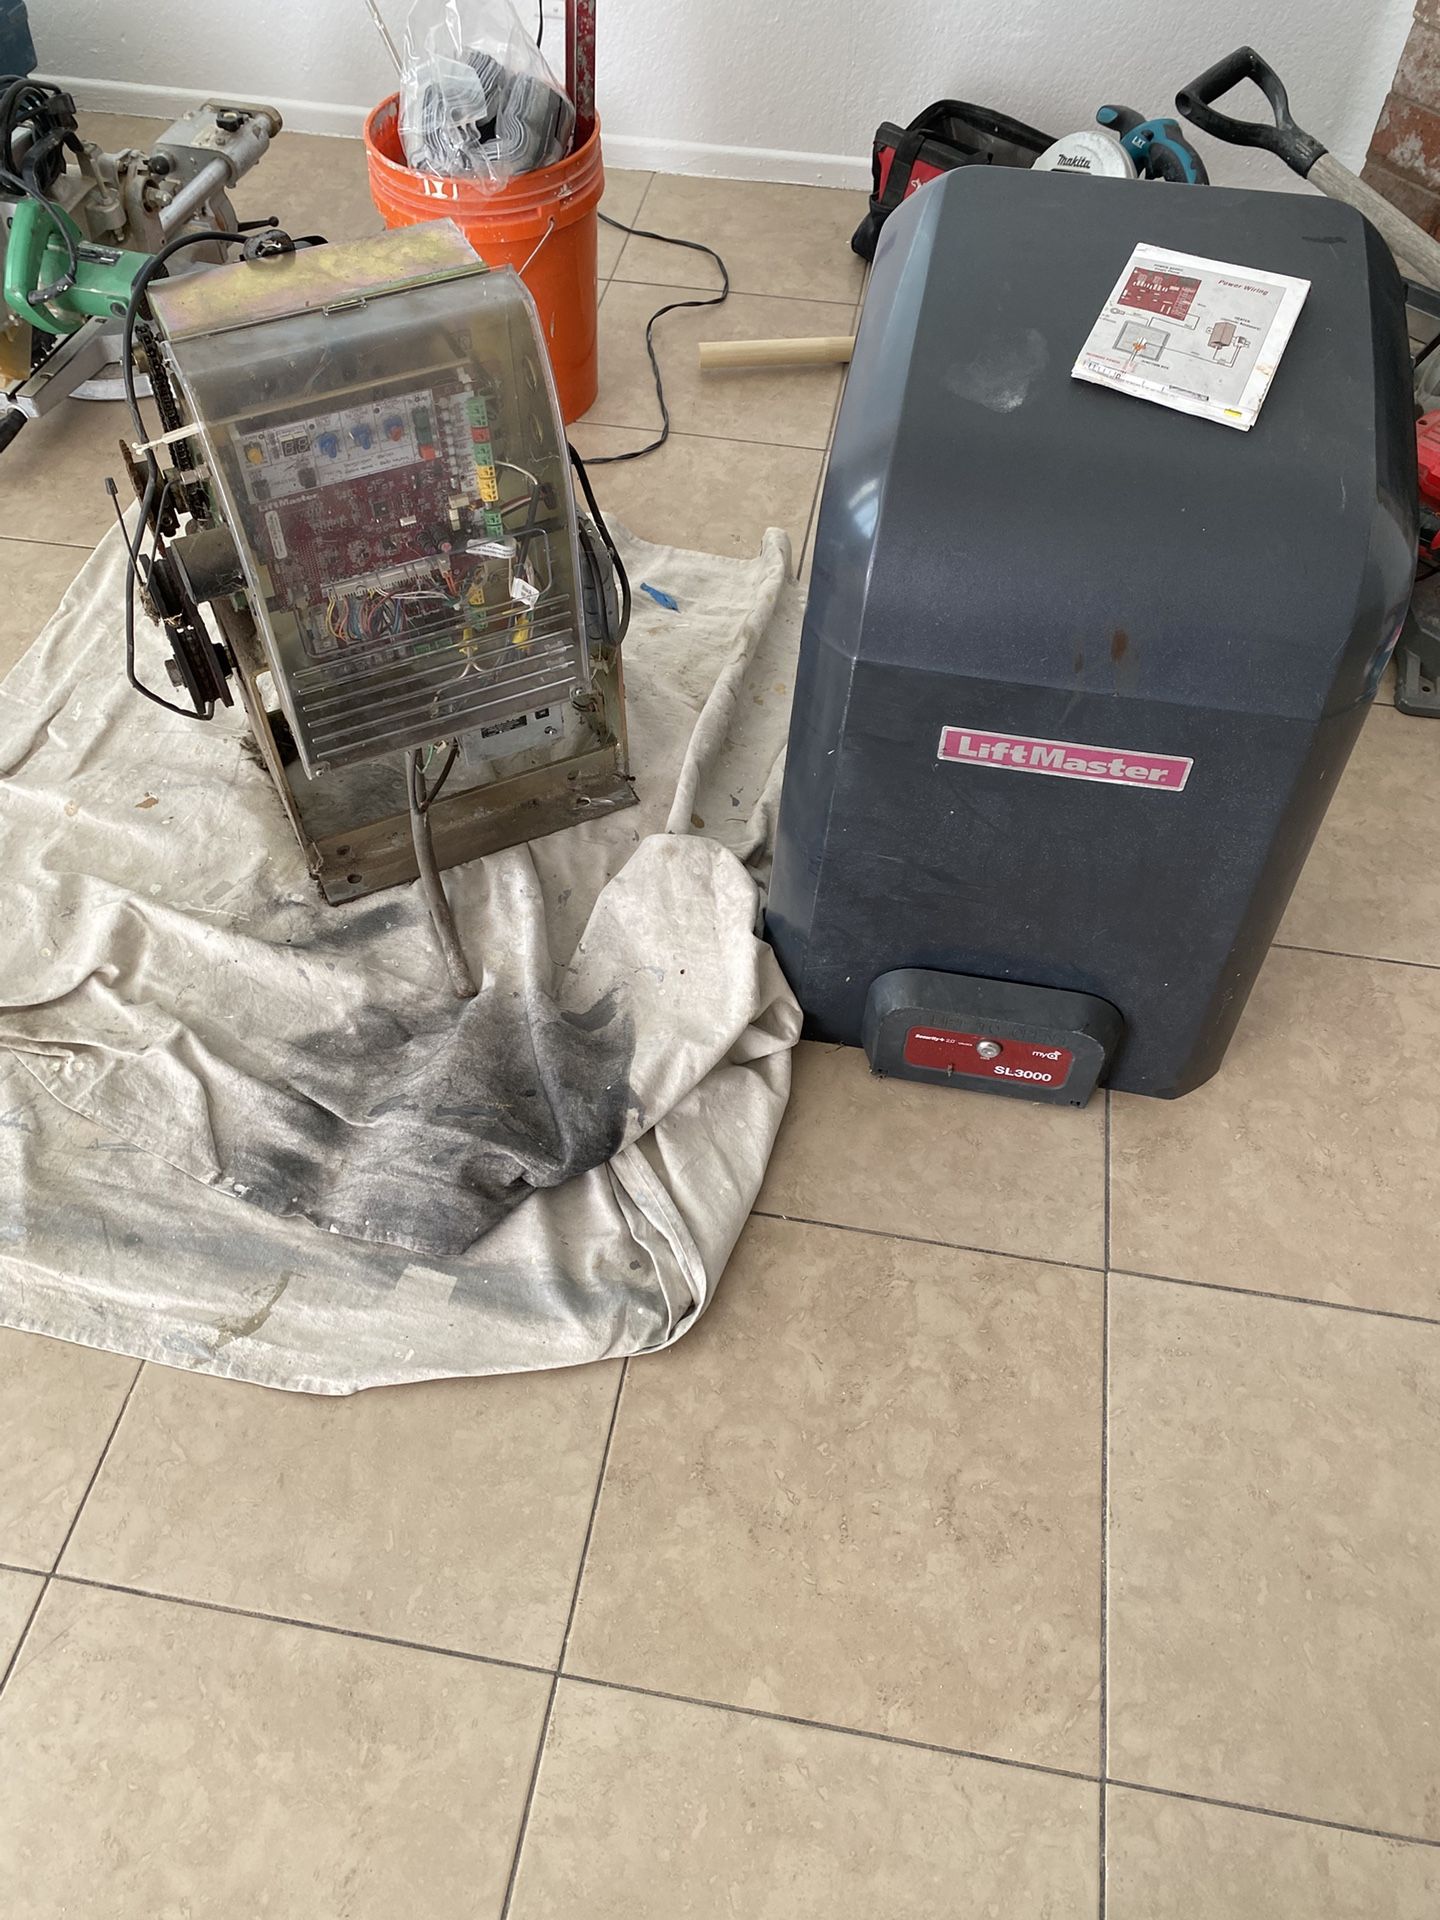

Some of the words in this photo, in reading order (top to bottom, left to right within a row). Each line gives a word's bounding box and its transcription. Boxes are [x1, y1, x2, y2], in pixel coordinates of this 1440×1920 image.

[1131, 136, 1146, 149] LXT
[1218, 279, 1242, 289] Power
[1243, 284, 1269, 296] Wiring
[258, 493, 318, 513] LiftMaster
[958, 735, 1169, 783] LiftMaster
[994, 1065, 1052, 1082] SL3000
